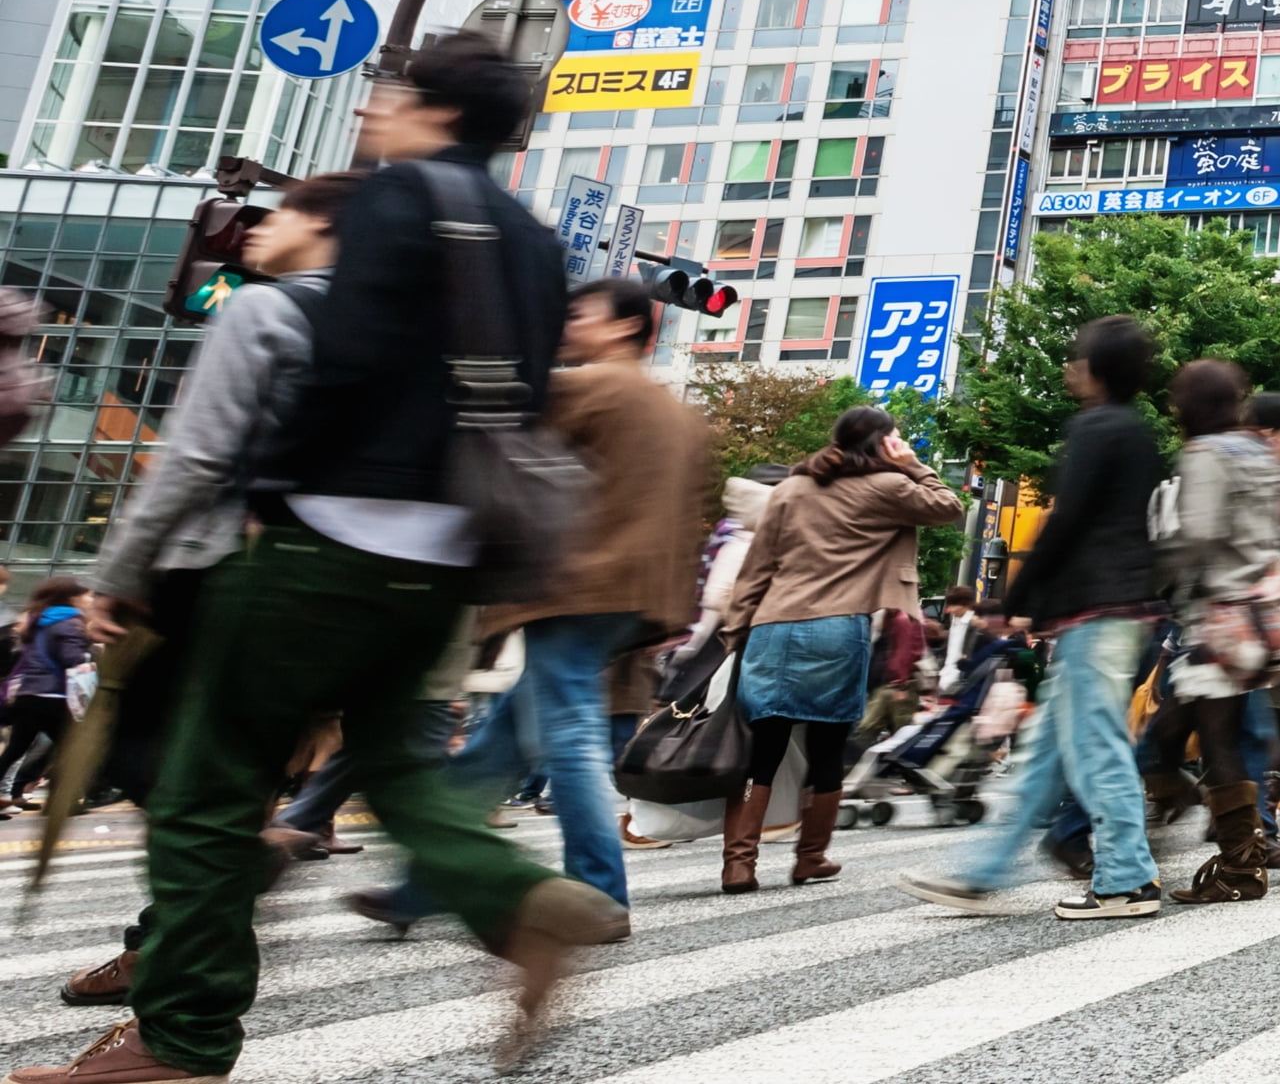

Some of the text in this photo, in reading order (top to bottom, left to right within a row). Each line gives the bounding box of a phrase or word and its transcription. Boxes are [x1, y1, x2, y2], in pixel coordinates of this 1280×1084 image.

[677, 0, 700, 11] 7F
[633, 26, 705, 48] 武富士
[552, 71, 648, 96] プロミス
[658, 70, 687, 89] 4F
[1102, 60, 1250, 94] プライス
[1039, 193, 1093, 212] AEON
[1104, 189, 1241, 211] 英会話イーオン
[1253, 191, 1272, 203] 6F
[562, 197, 581, 236] Shibuya
[567, 188, 605, 275] 渋谷駅前
